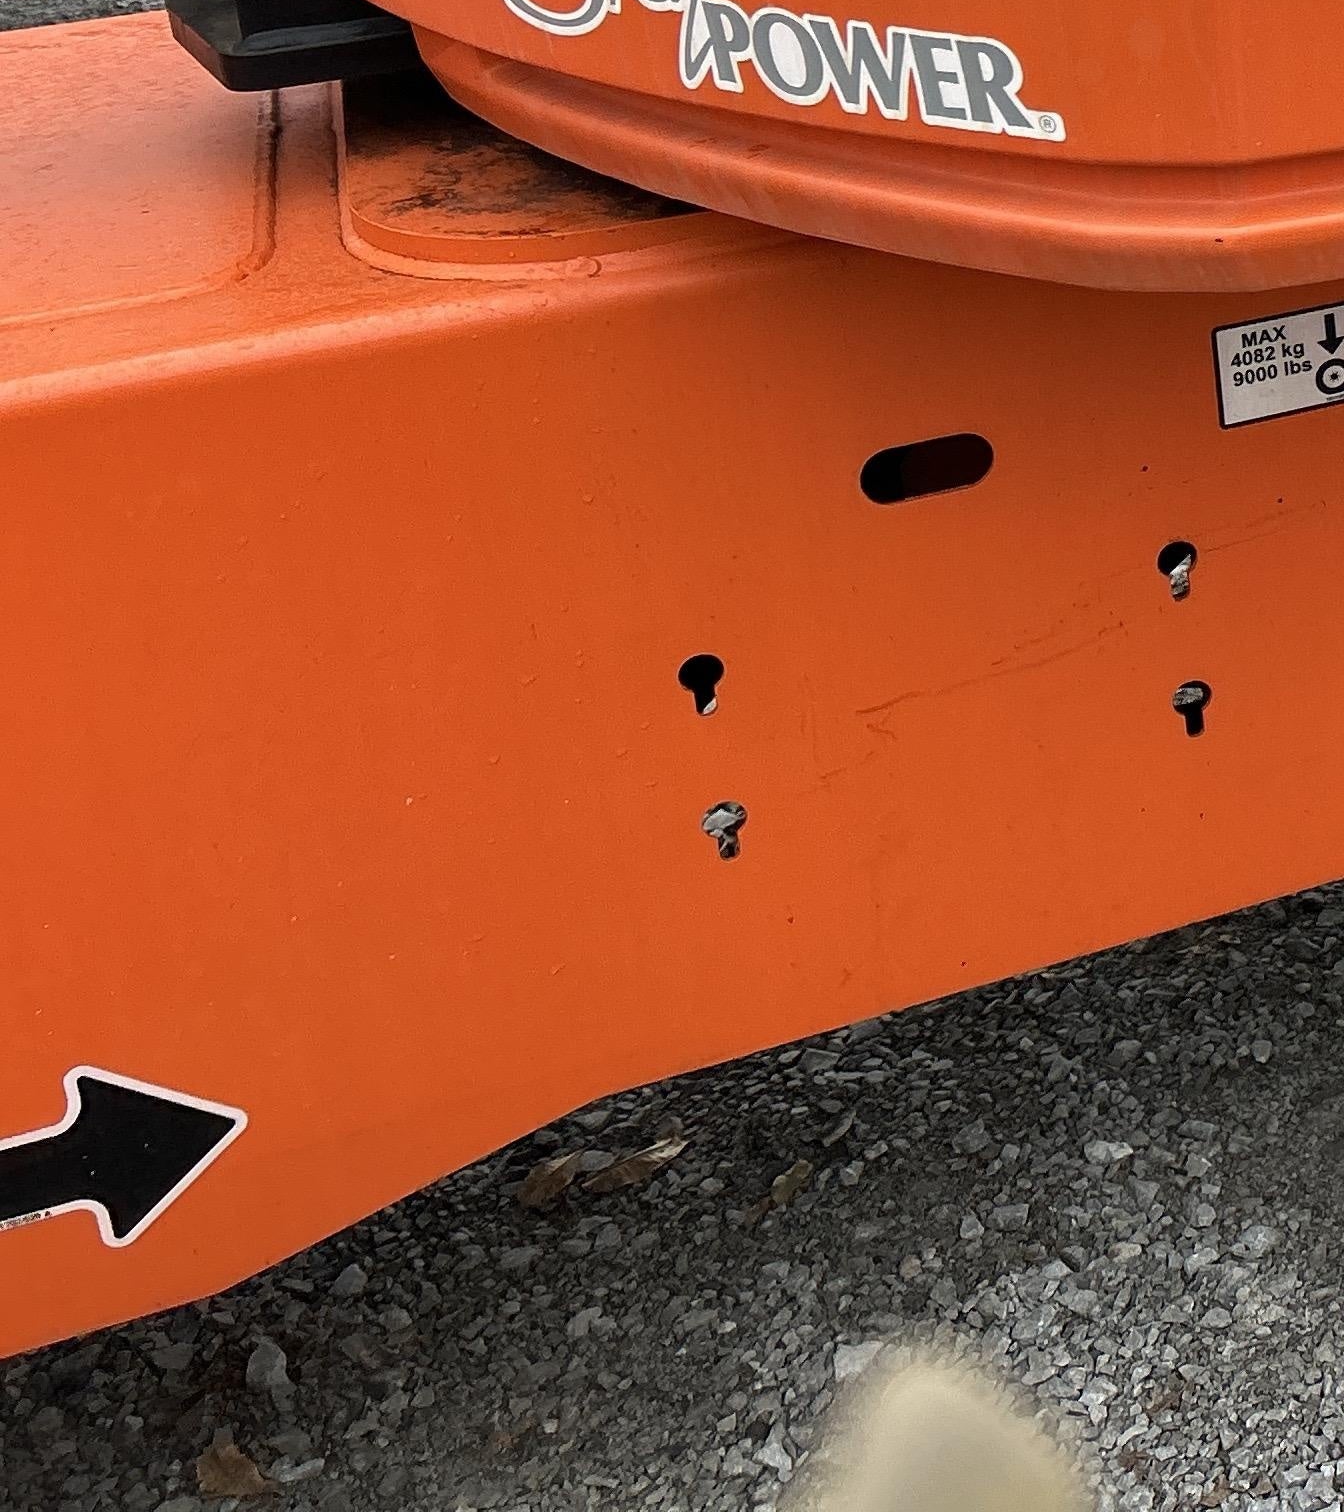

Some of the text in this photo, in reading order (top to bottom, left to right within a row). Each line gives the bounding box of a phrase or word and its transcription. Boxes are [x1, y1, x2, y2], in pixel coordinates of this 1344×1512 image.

[1241, 325, 1287, 349] MAX
[1231, 342, 1305, 368] 4082 kg
[1233, 360, 1313, 387] 9000 lbs
